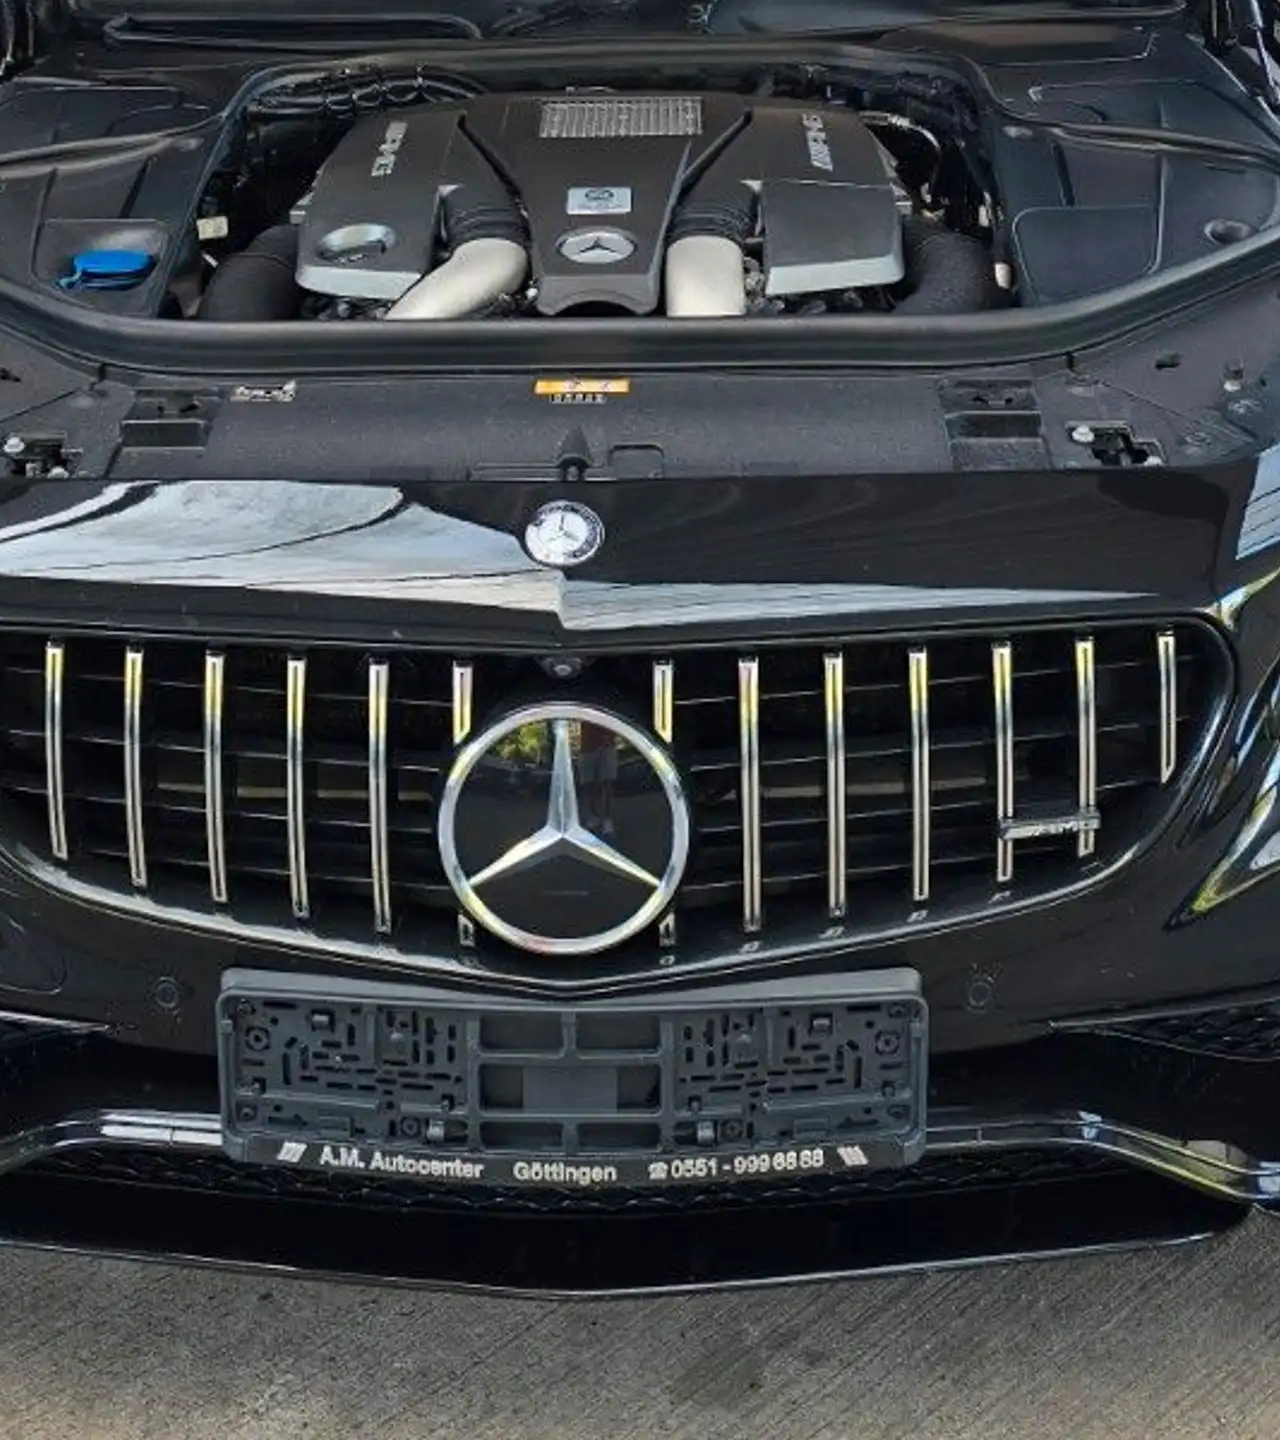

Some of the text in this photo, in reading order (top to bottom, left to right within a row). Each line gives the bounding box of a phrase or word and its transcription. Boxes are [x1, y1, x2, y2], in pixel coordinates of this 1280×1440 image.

[320, 1145, 365, 1168] A.M.
[370, 1151, 485, 1179] Autocenter
[513, 1161, 618, 1185] Göttingen
